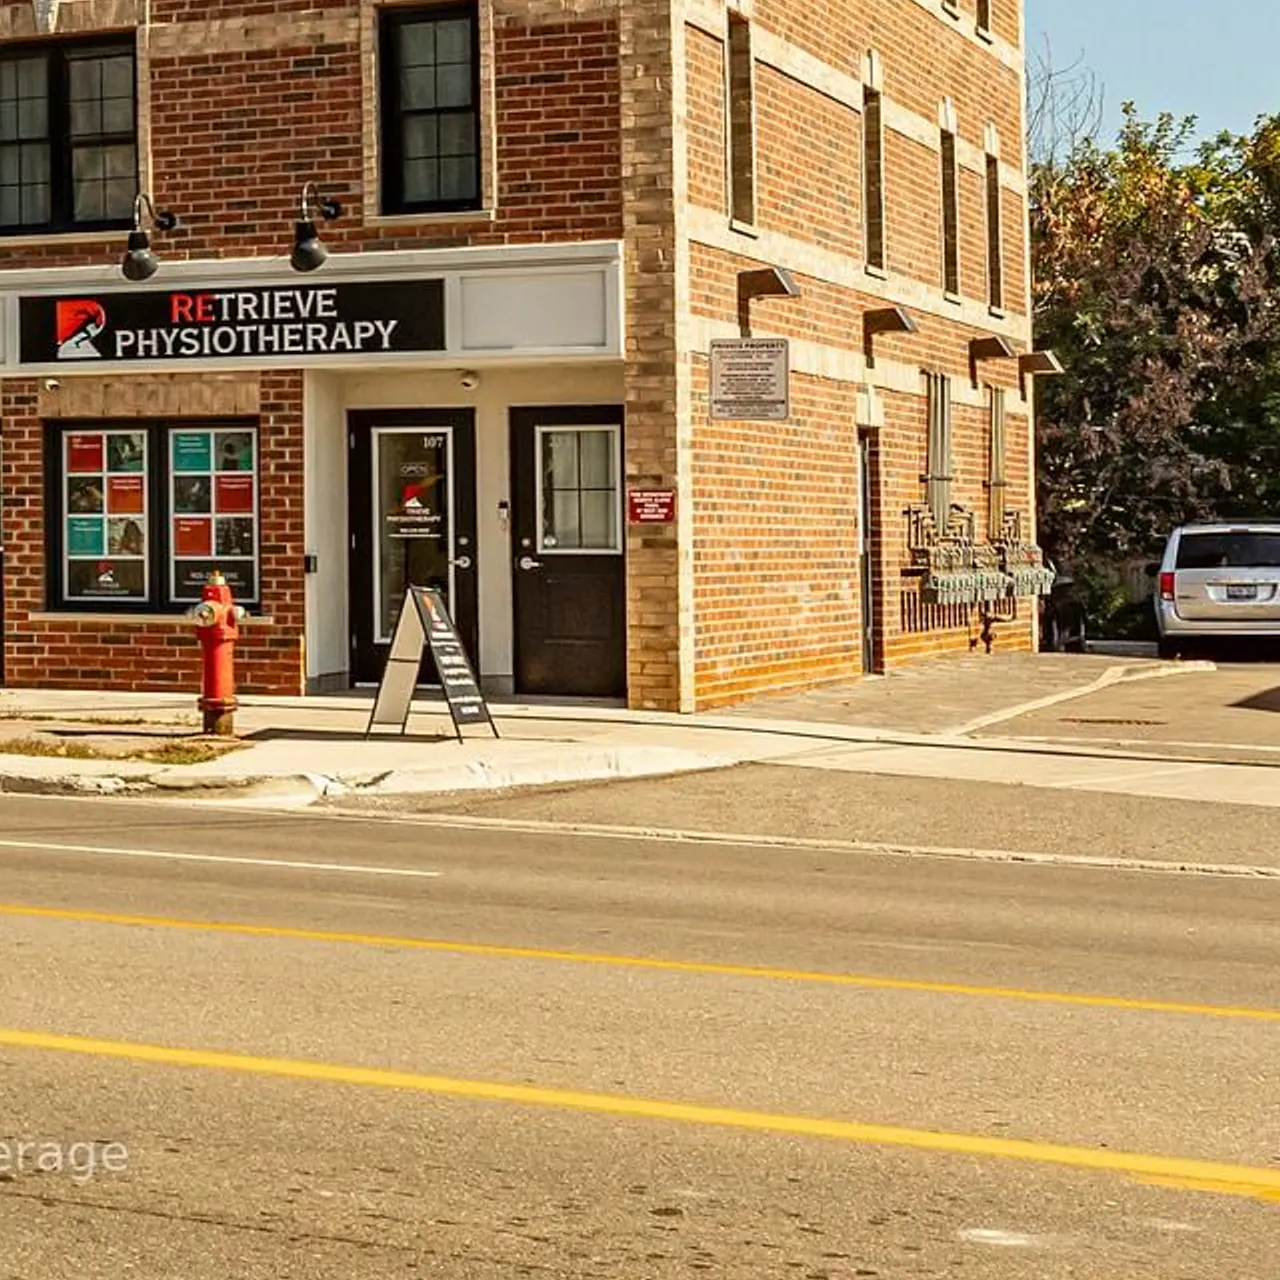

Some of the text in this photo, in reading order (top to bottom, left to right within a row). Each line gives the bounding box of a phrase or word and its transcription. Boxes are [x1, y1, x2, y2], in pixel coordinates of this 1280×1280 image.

[172, 289, 337, 322] RETRIEVE
[115, 320, 397, 357] PHYSIOTHERAPY
[423, 436, 444, 449] 107
